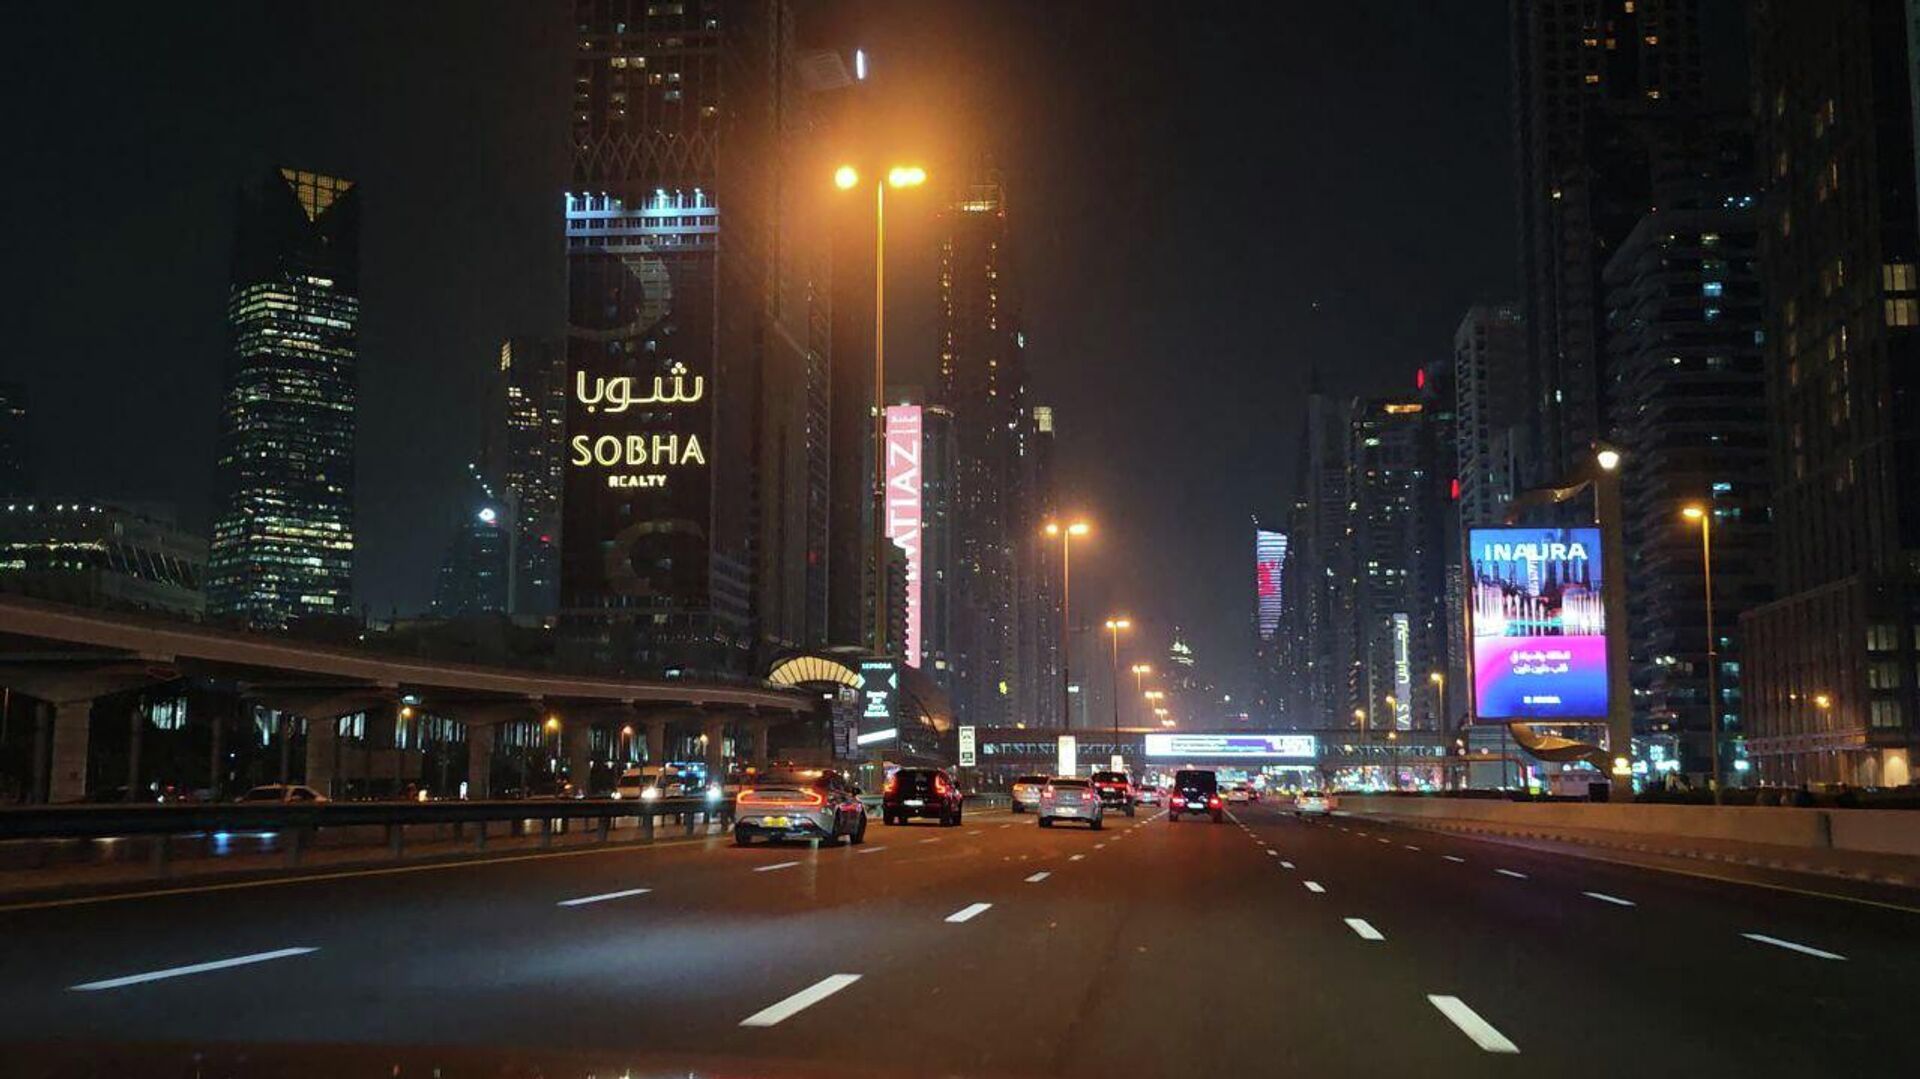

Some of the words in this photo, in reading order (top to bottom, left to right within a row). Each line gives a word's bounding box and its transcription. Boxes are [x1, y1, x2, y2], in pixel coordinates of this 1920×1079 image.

[577, 361, 704, 413] شوبا
[572, 434, 706, 466] SOBHA
[1484, 543, 1588, 561] INAURA
